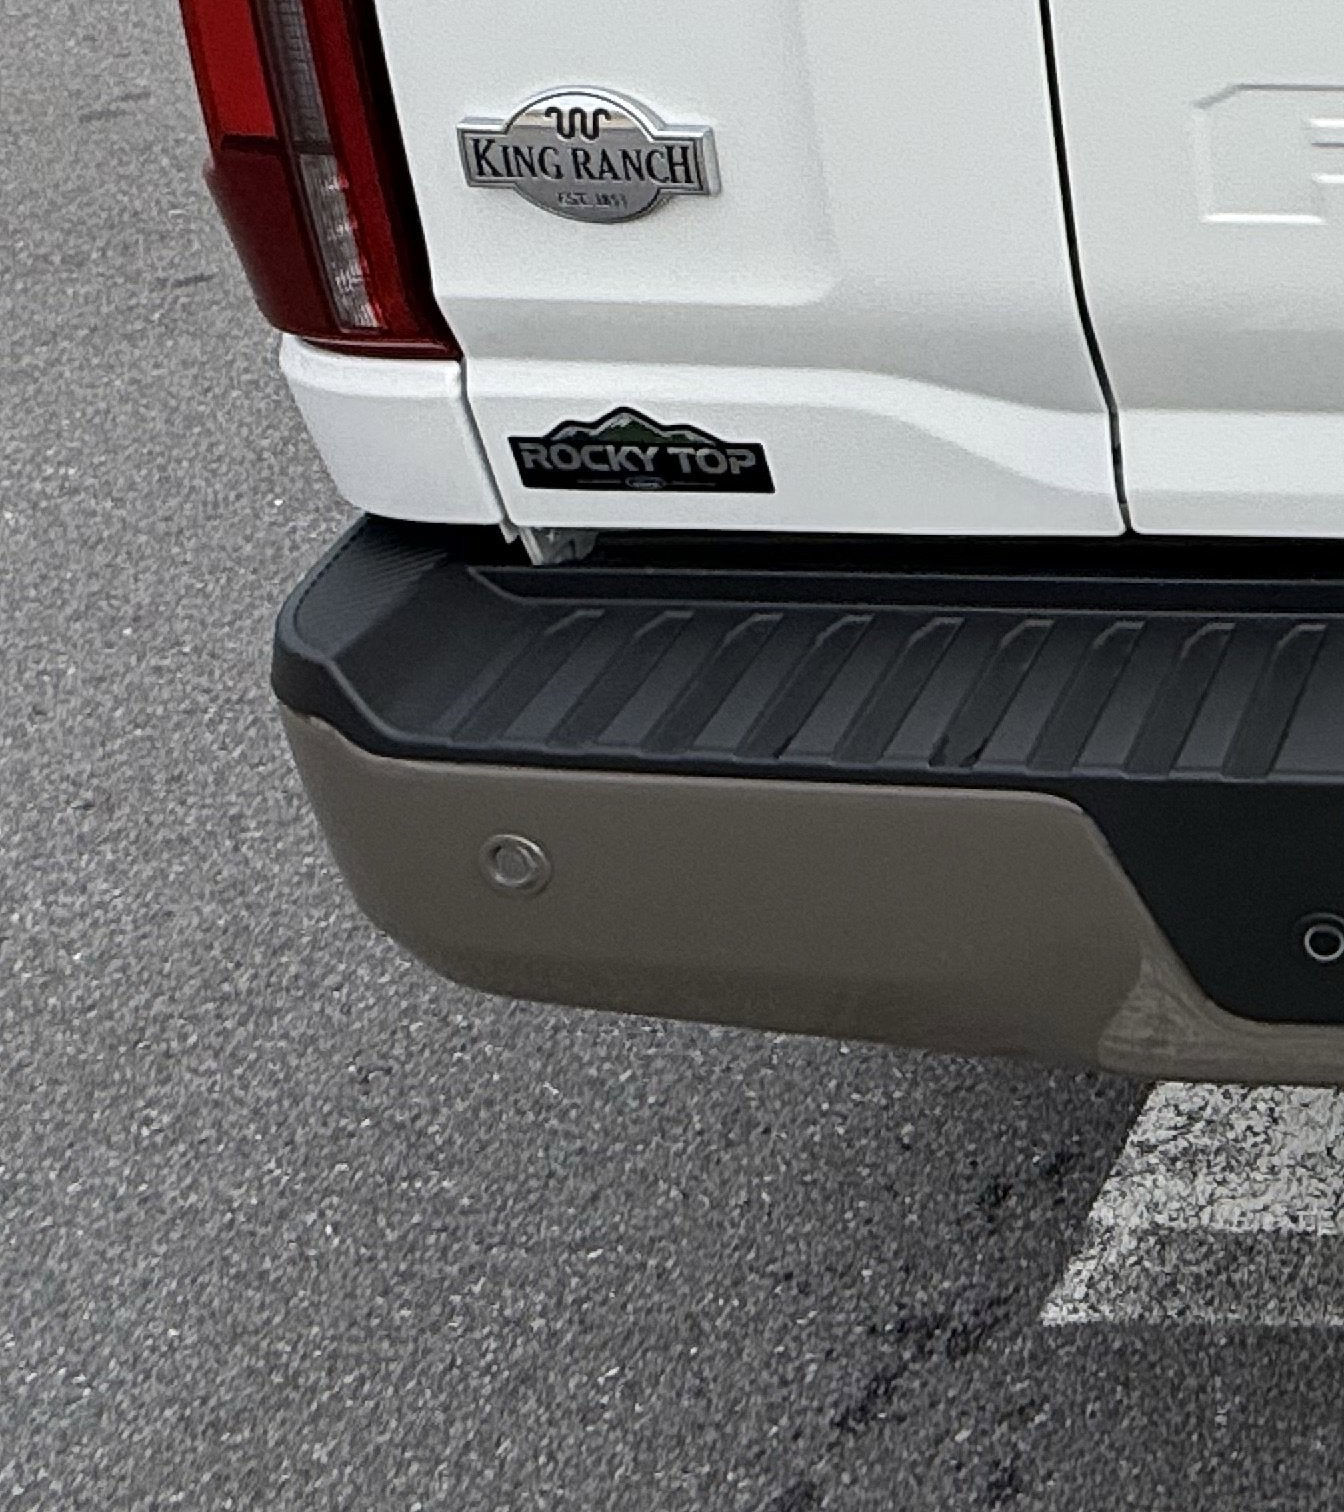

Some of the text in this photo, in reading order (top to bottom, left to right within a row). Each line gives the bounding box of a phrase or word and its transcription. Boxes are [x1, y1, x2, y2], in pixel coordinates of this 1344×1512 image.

[471, 137, 697, 185] KING RANCH
[519, 442, 757, 476] ROCKY TOP
